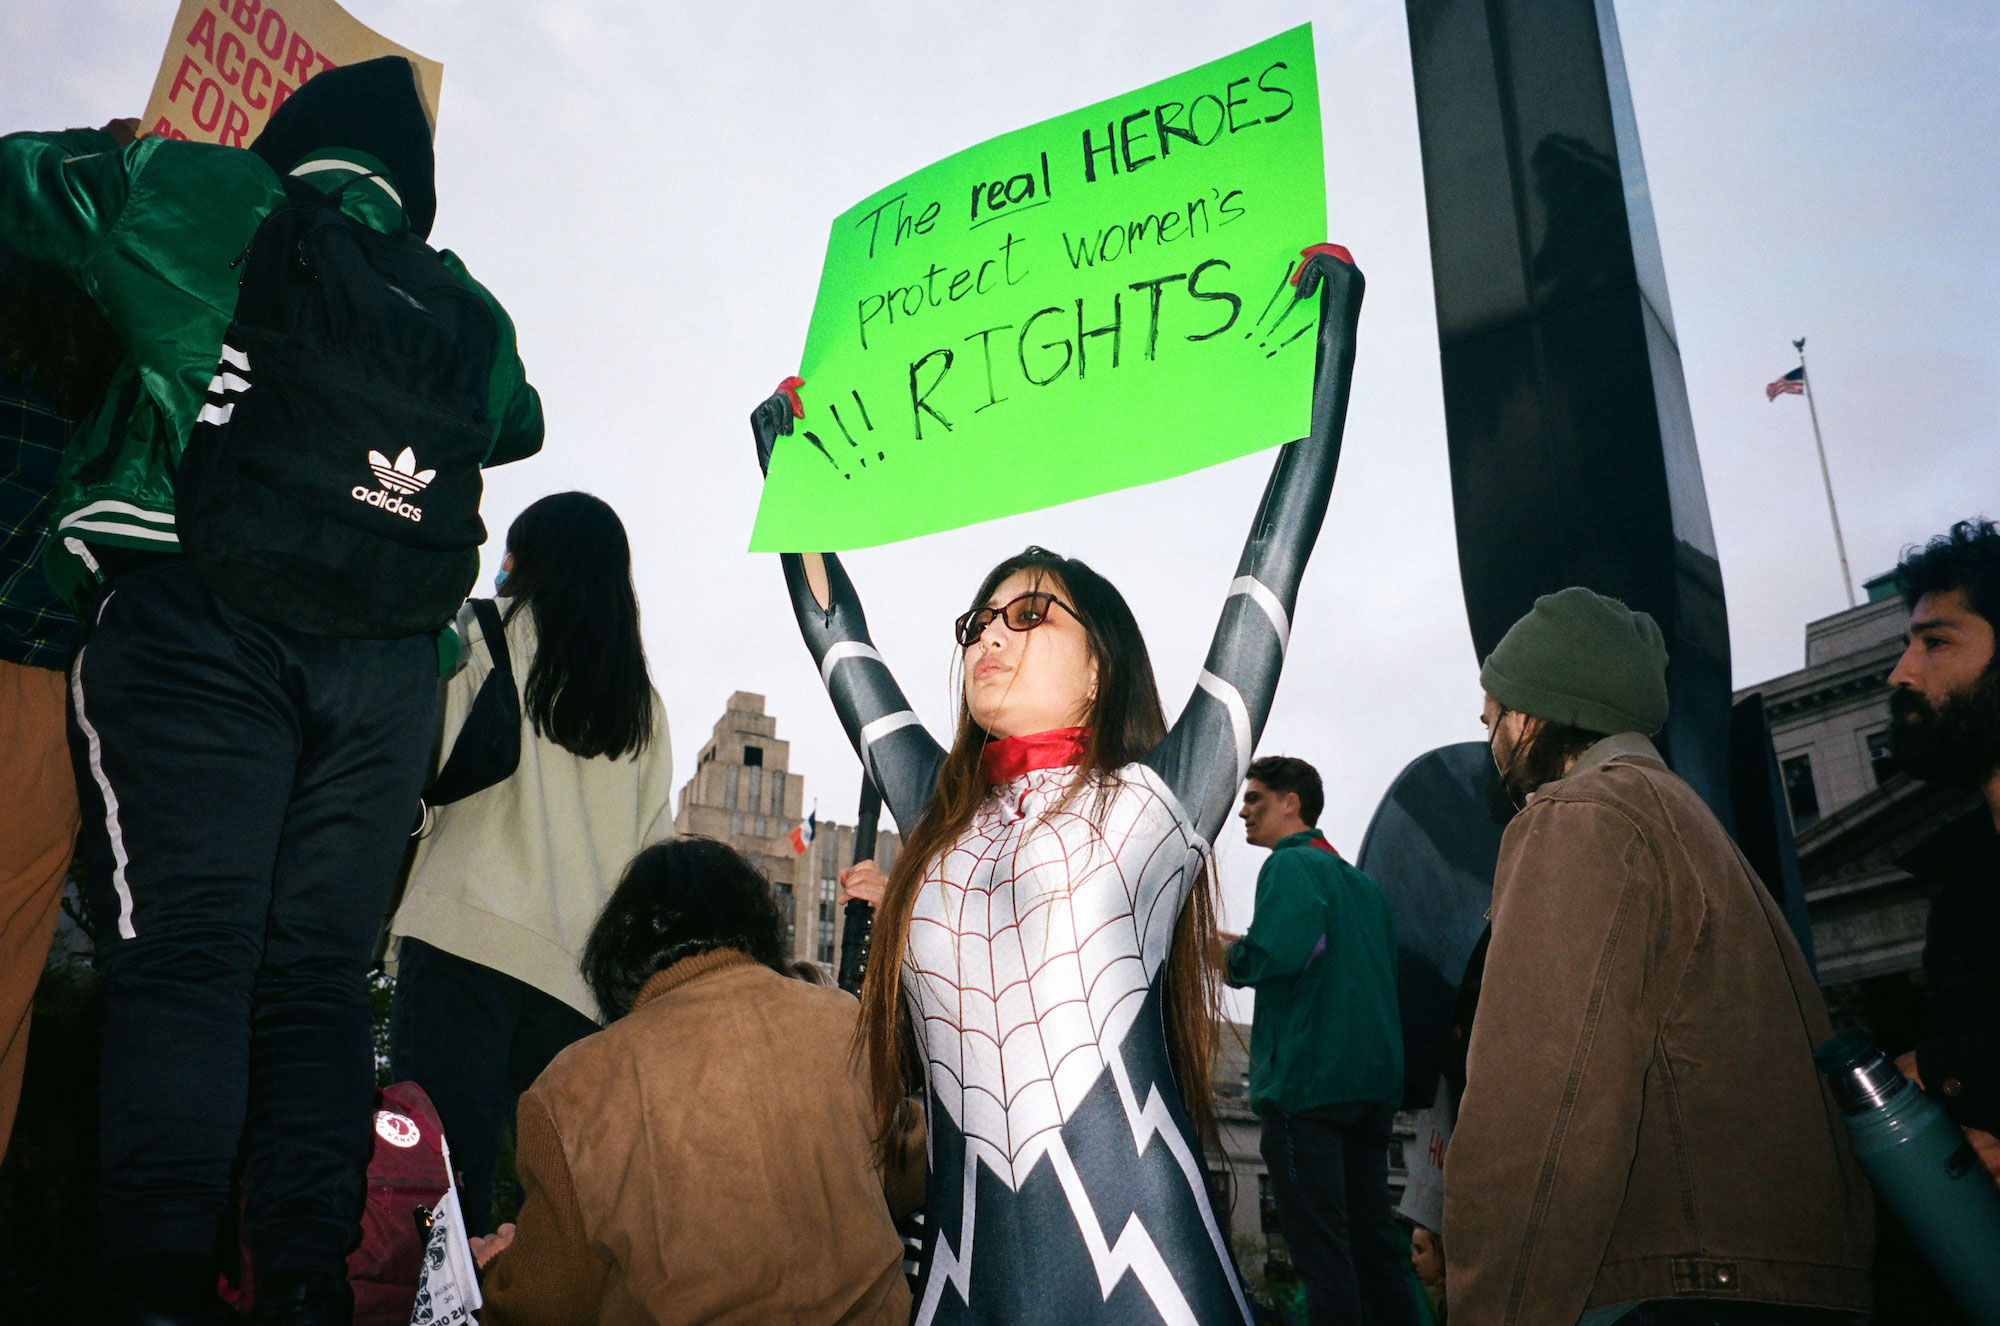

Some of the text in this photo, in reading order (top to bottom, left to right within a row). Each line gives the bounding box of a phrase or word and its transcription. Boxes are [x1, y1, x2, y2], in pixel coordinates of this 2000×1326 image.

[219, 0, 338, 86] BOR
[168, 54, 250, 150] FOR
[855, 61, 1295, 259] The real HEROES
[857, 187, 1246, 350] protect women's
[351, 485, 423, 523] adidas
